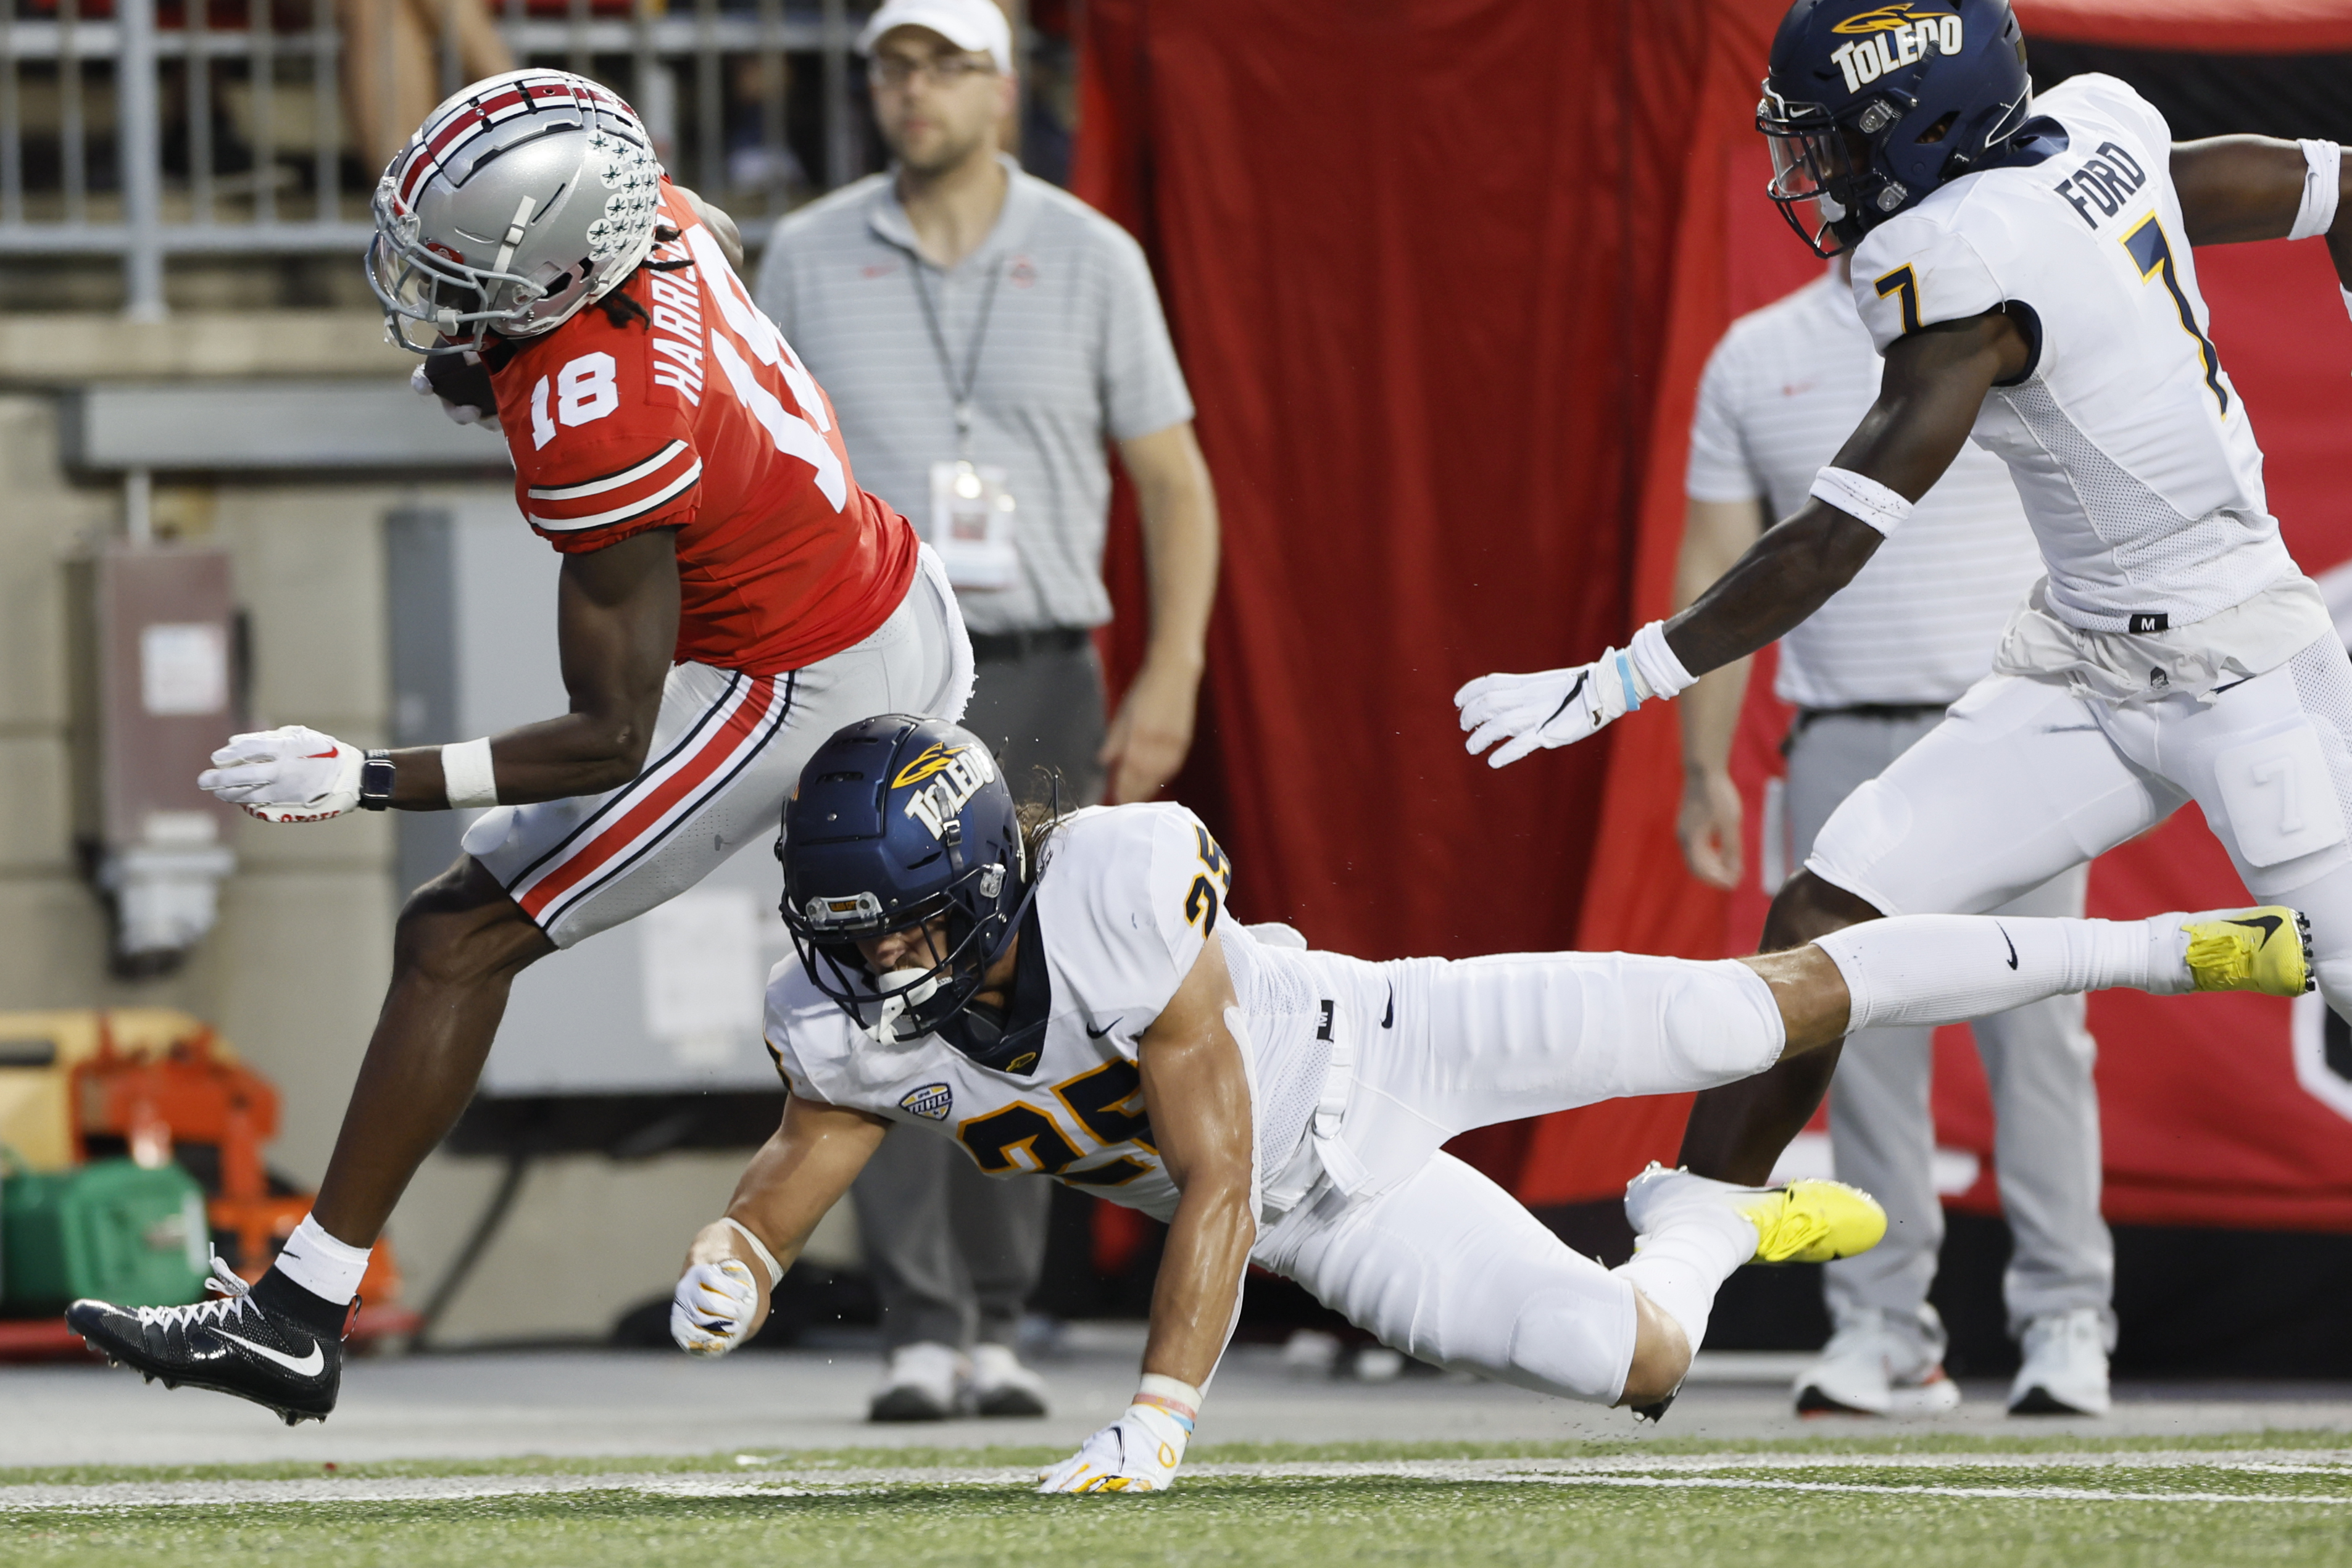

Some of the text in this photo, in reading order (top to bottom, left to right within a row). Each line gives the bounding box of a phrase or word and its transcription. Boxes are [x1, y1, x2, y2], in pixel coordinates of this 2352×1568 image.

[1830, 15, 1963, 94] TOLEDO
[2054, 141, 2146, 231] FORD
[1873, 261, 1925, 334] 7
[2118, 208, 2227, 423] 7
[531, 351, 619, 451] 18
[2140, 618, 2156, 631] M
[904, 744, 995, 841] TOLEDO
